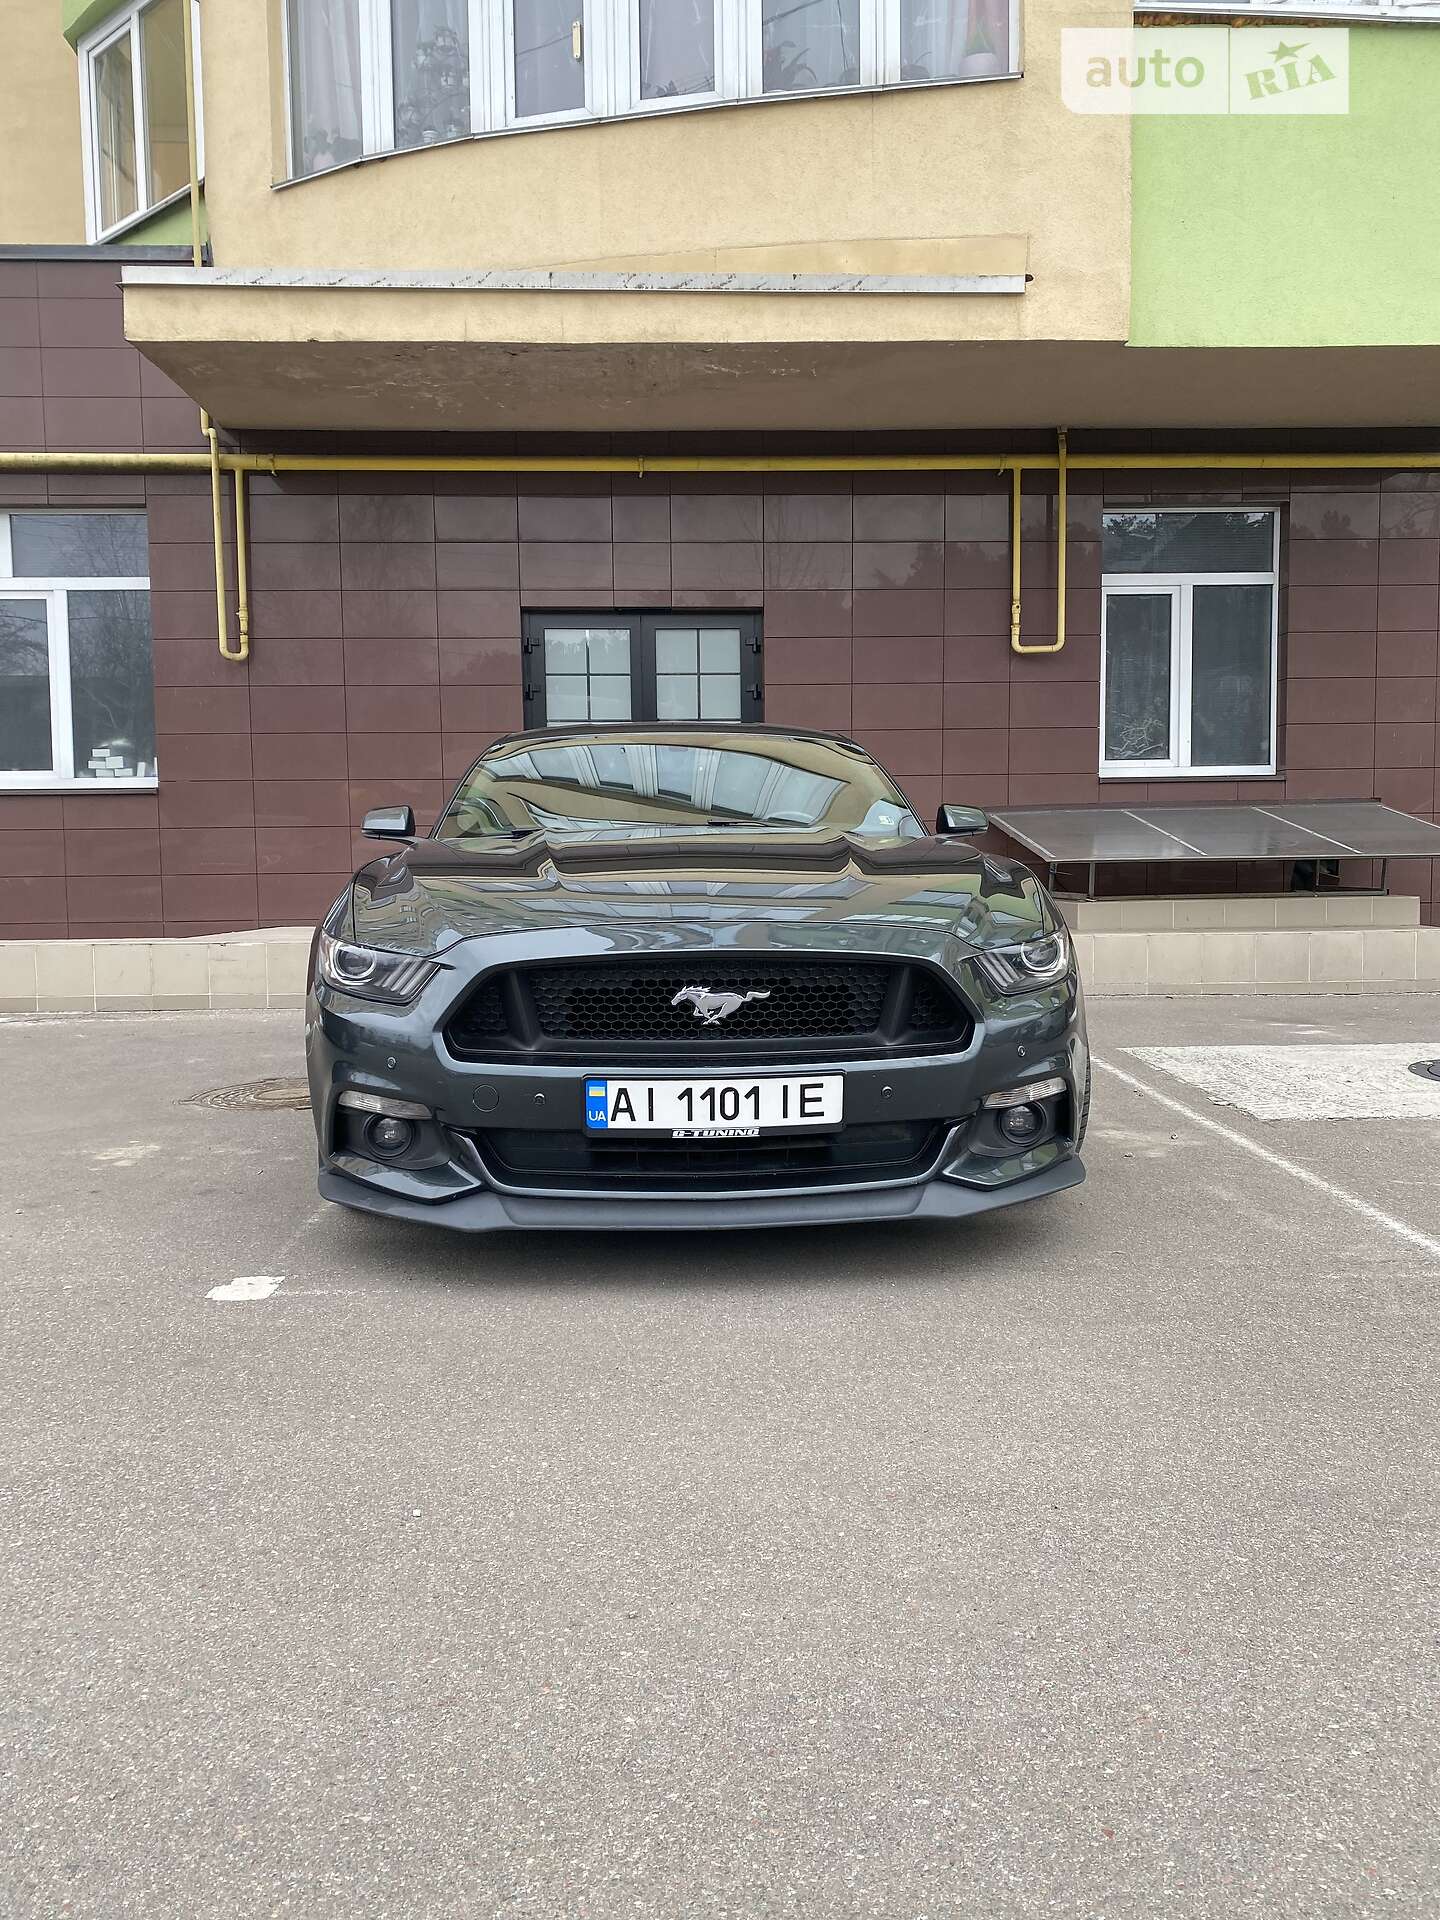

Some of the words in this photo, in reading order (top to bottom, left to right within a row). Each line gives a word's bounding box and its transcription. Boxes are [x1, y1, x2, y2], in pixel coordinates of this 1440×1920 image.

[610, 1087, 654, 1122] AI
[677, 1085, 760, 1122] 1101
[782, 1082, 825, 1119] IE
[588, 1110, 607, 1122] UA
